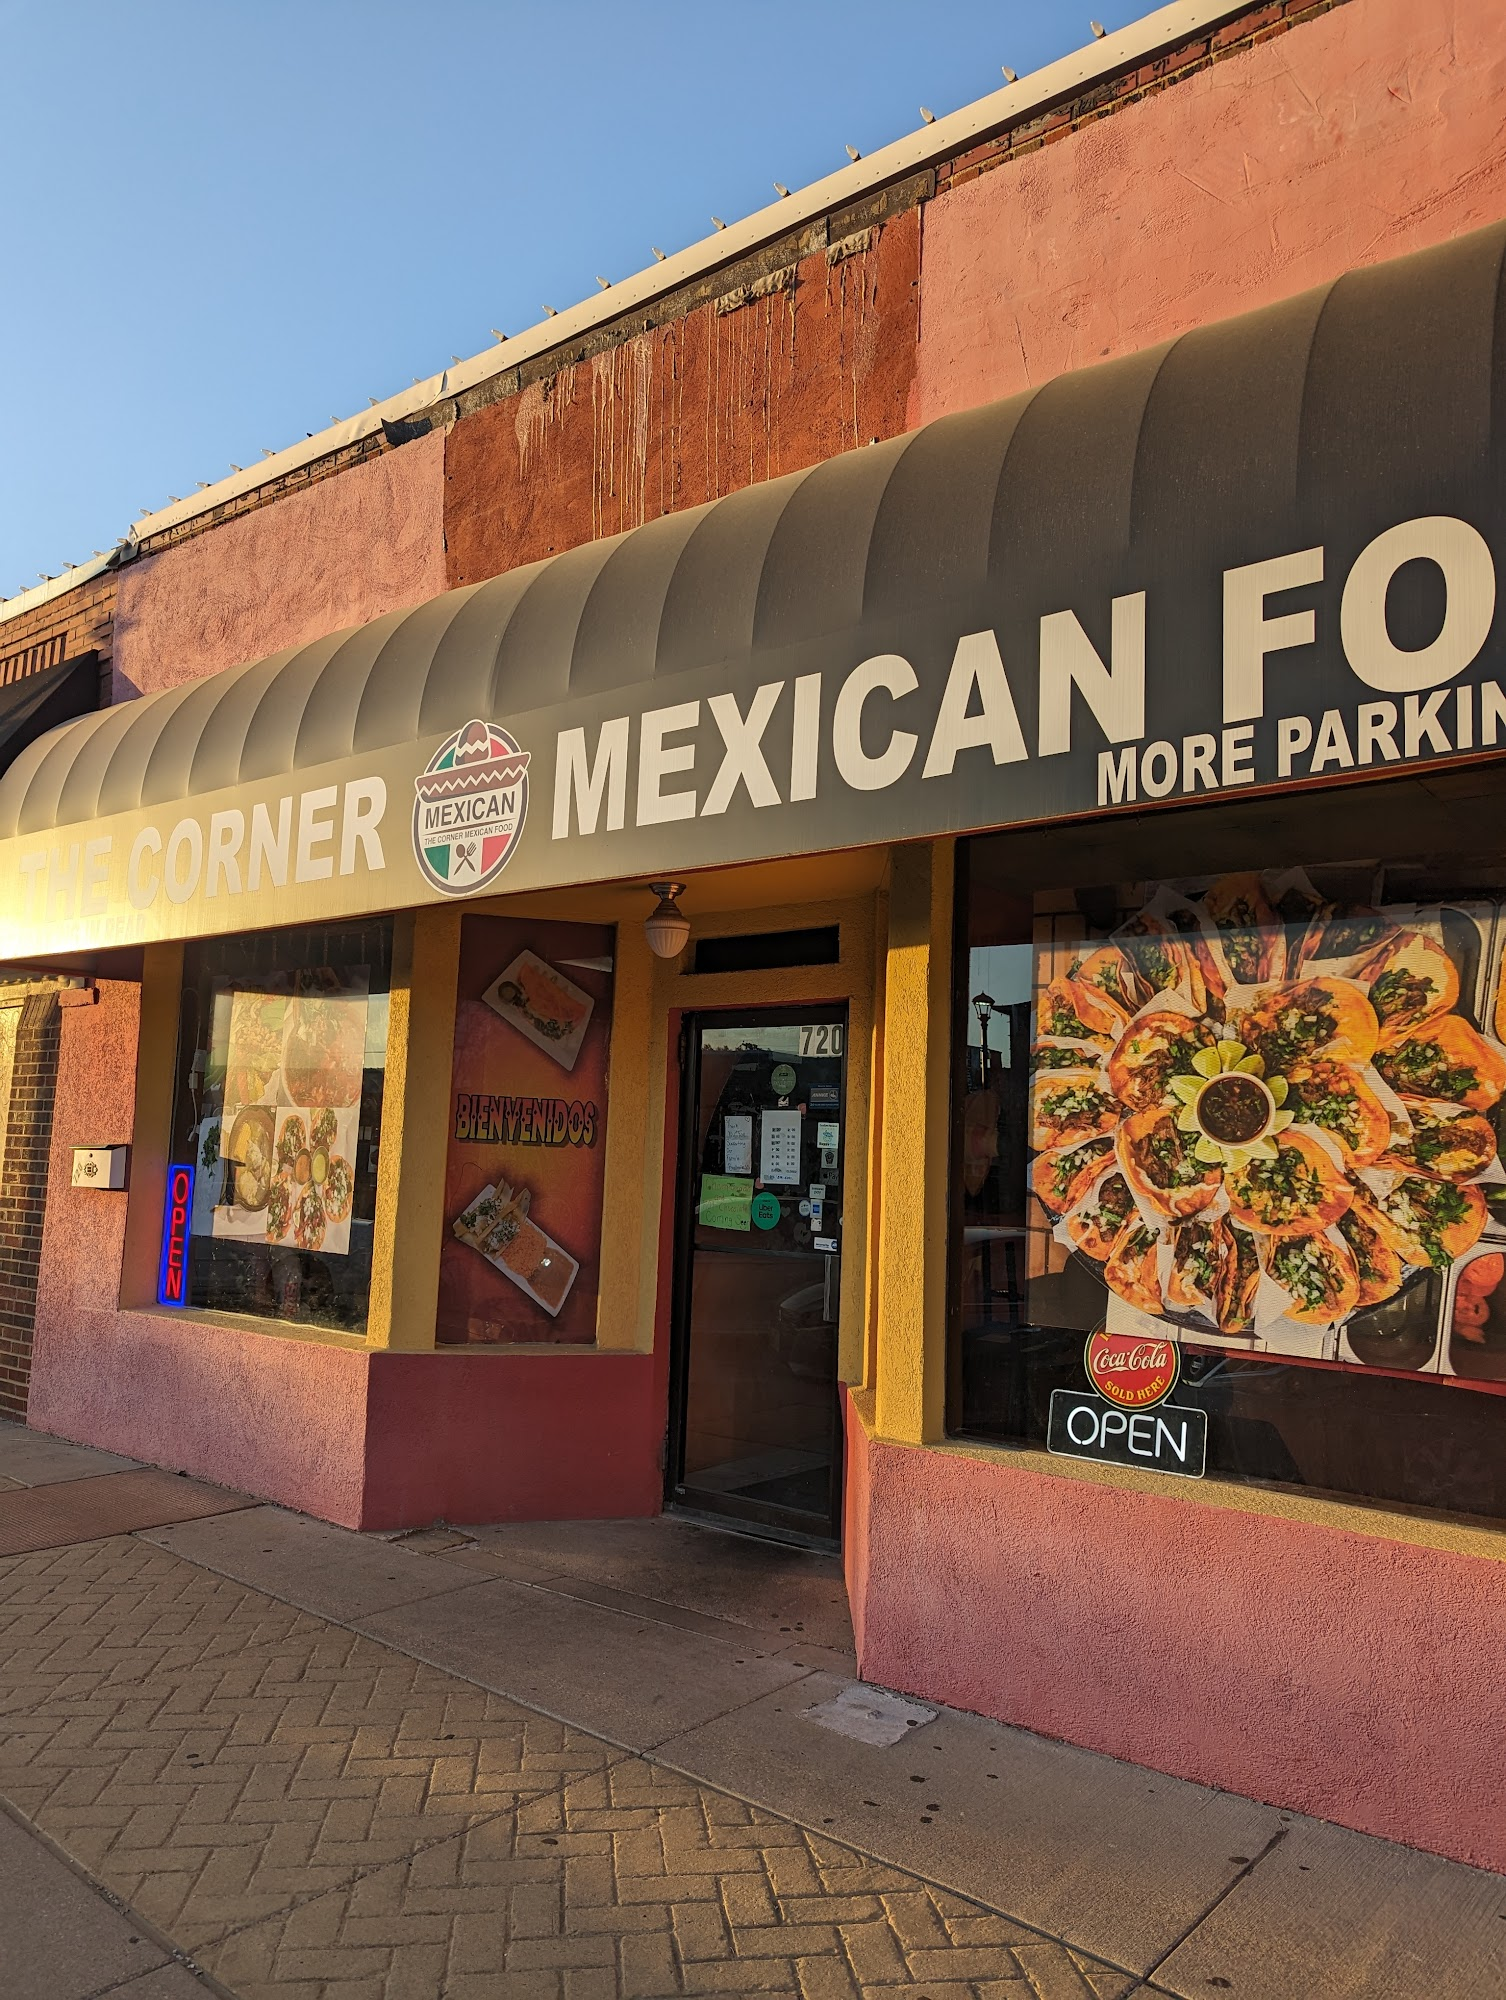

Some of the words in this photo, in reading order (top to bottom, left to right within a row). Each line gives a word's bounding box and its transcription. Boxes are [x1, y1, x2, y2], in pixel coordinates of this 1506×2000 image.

[552, 590, 1146, 840] MEXICAN
[1097, 724, 1255, 806] MORE
[424, 836, 436, 845] THE
[437, 832, 463, 843] CORNER
[464, 827, 493, 838] MEXICAN
[494, 823, 513, 832] FOOD
[425, 791, 515, 829] MEXICAN
[19, 835, 113, 924] THE
[127, 776, 386, 910] CORNER
[802, 1025, 843, 1055] 720
[455, 1094, 596, 1146] BIENVENIDOS
[165, 1172, 189, 1298] OPEN
[1093, 1342, 1167, 1375] Coca-Cola
[1105, 1380, 1134, 1400] SOLD
[1137, 1375, 1165, 1399] HERE
[1067, 1406, 1187, 1462] OPEN
